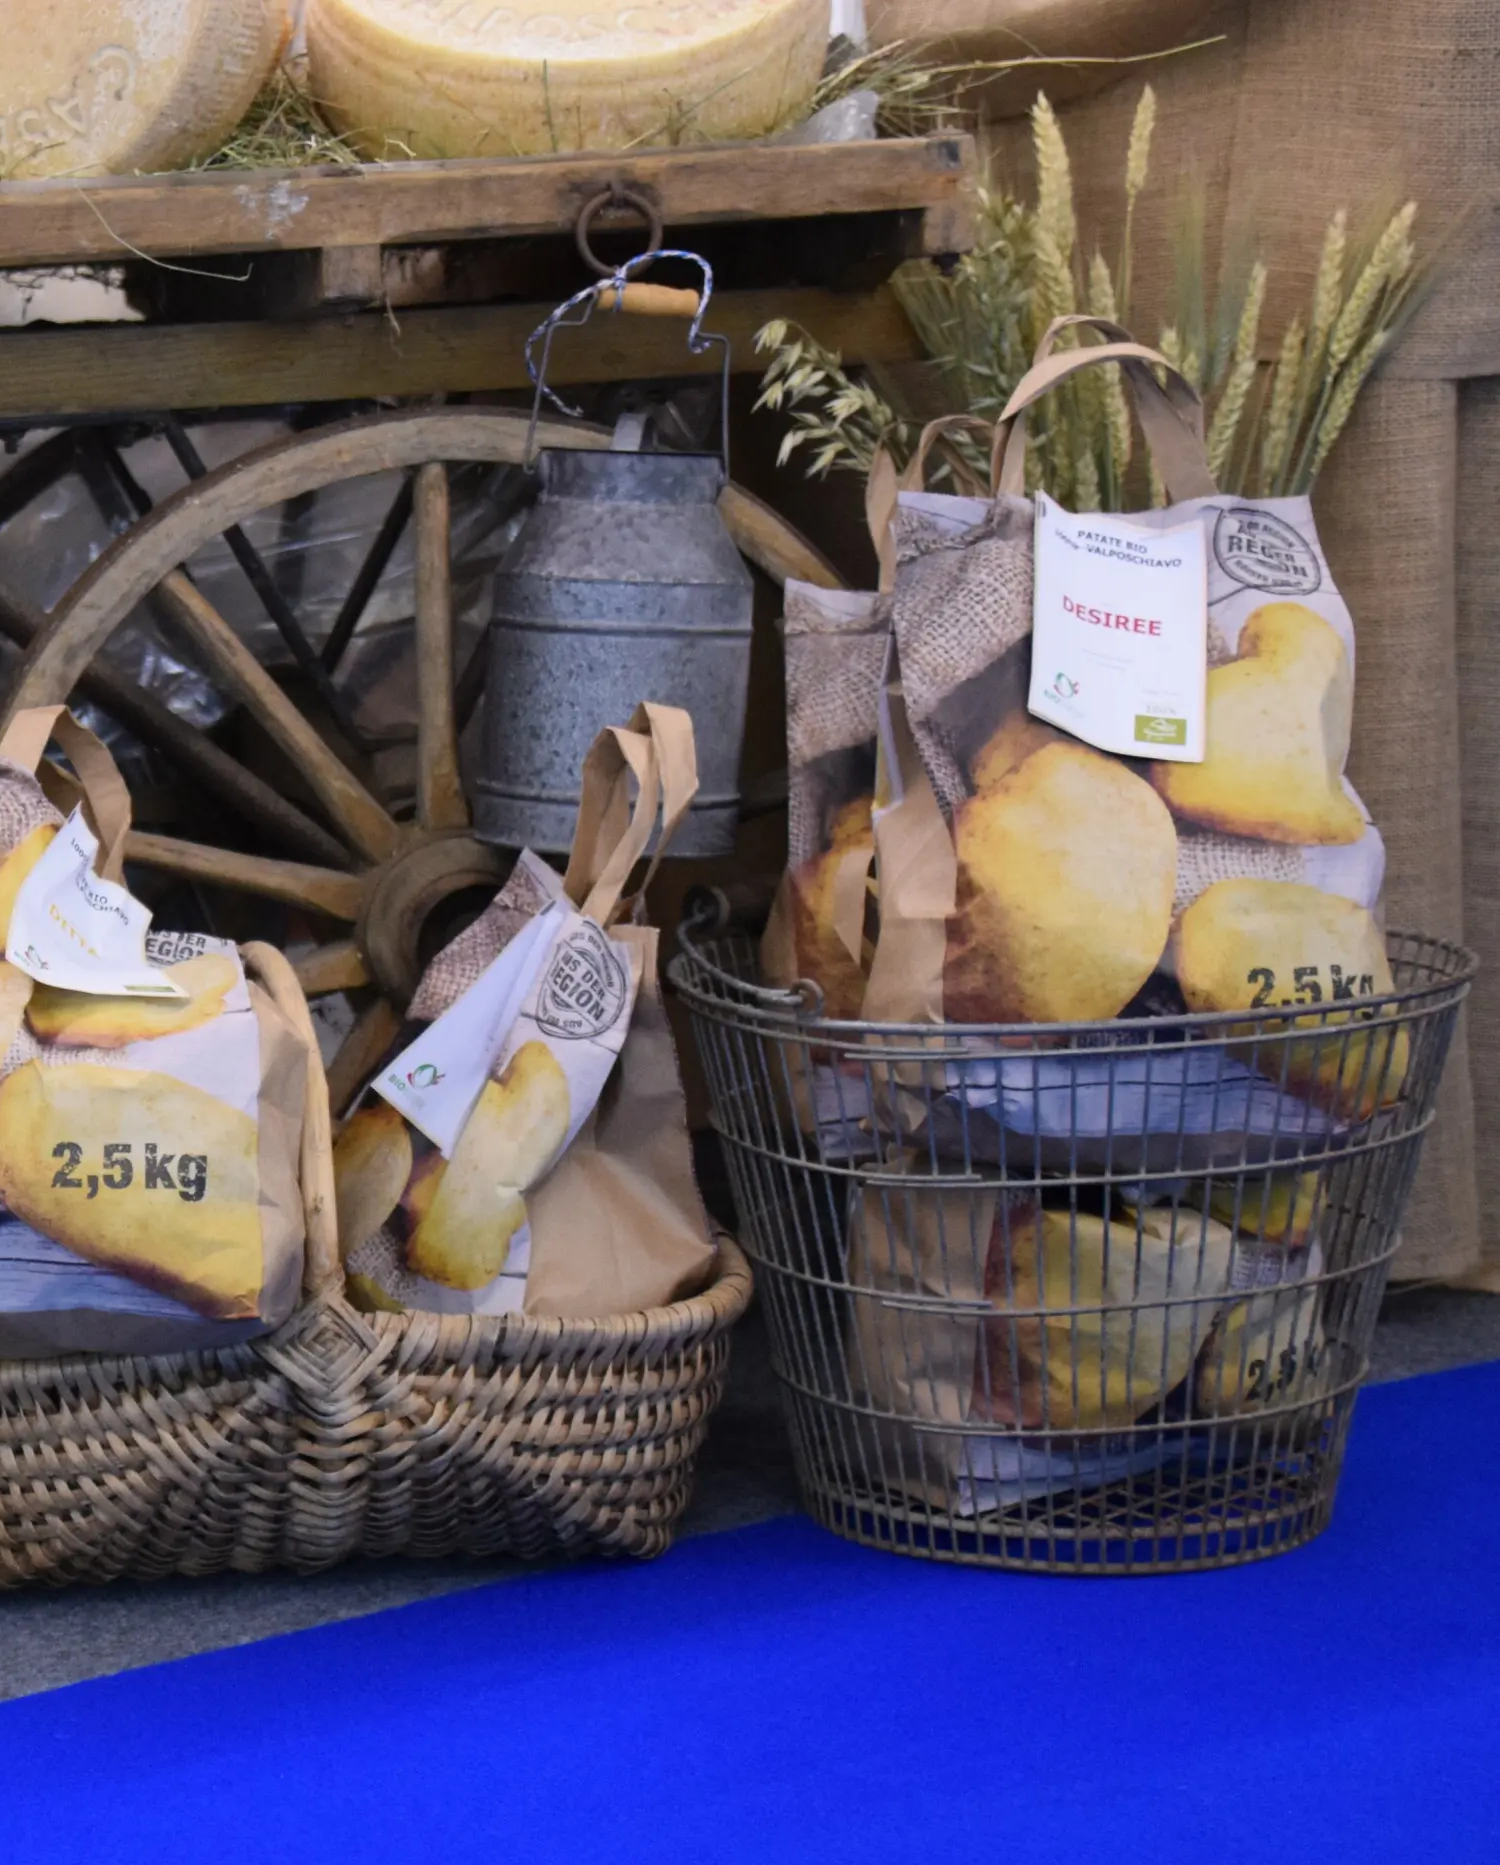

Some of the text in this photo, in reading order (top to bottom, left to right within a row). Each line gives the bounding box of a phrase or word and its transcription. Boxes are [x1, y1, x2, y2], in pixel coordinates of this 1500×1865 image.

[1077, 530, 1148, 555] PATATE BIO
[1086, 544, 1183, 569] VALPOSCHIAVO
[1063, 594, 1163, 637] DESIREE
[145, 938, 205, 960] EGIO
[551, 962, 606, 1022] EGION
[561, 950, 606, 1001] US DER
[51, 1141, 208, 1203] 2,5 kg
